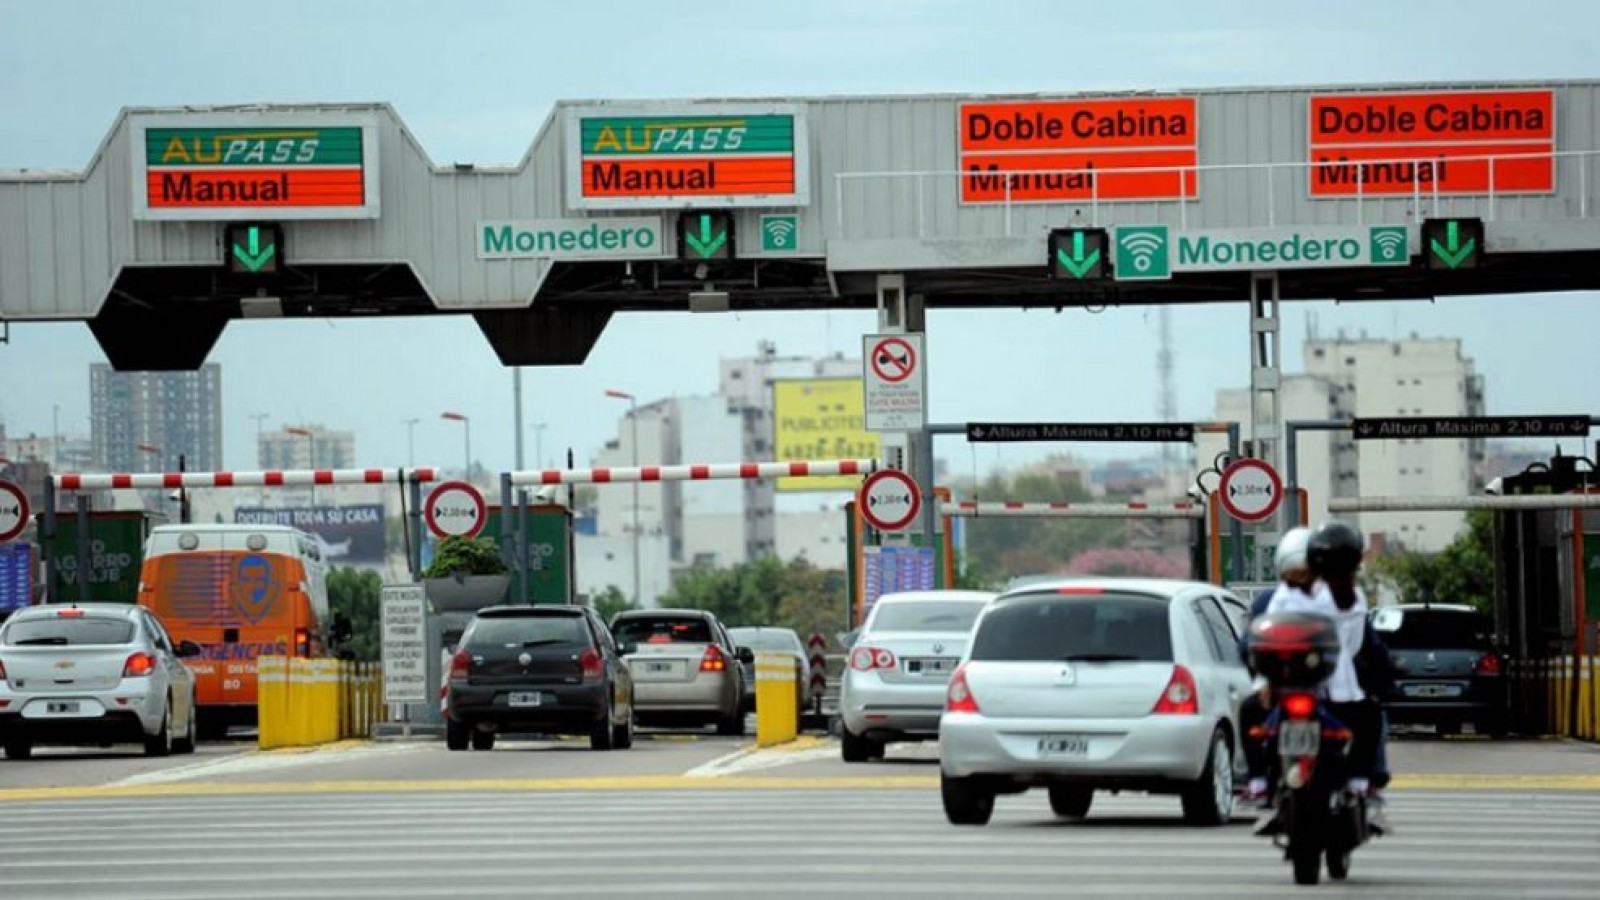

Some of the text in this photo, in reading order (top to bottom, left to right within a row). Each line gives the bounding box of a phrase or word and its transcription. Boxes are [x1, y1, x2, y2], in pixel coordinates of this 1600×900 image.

[968, 109, 1187, 141] Doble Cabina
[1318, 103, 1545, 134] Doble Cabina
[591, 161, 716, 192] Manual
[969, 162, 1095, 192] Manual
[1318, 155, 1447, 185] Manual
[161, 174, 289, 202] Manual
[484, 224, 655, 253] Monedero
[1179, 234, 1361, 265] Monedero
[988, 425, 1037, 439] Altura
[1156, 426, 1172, 438] m
[1378, 420, 1429, 436] Altura
[1549, 420, 1565, 432] m
[345, 508, 378, 522] CASA
